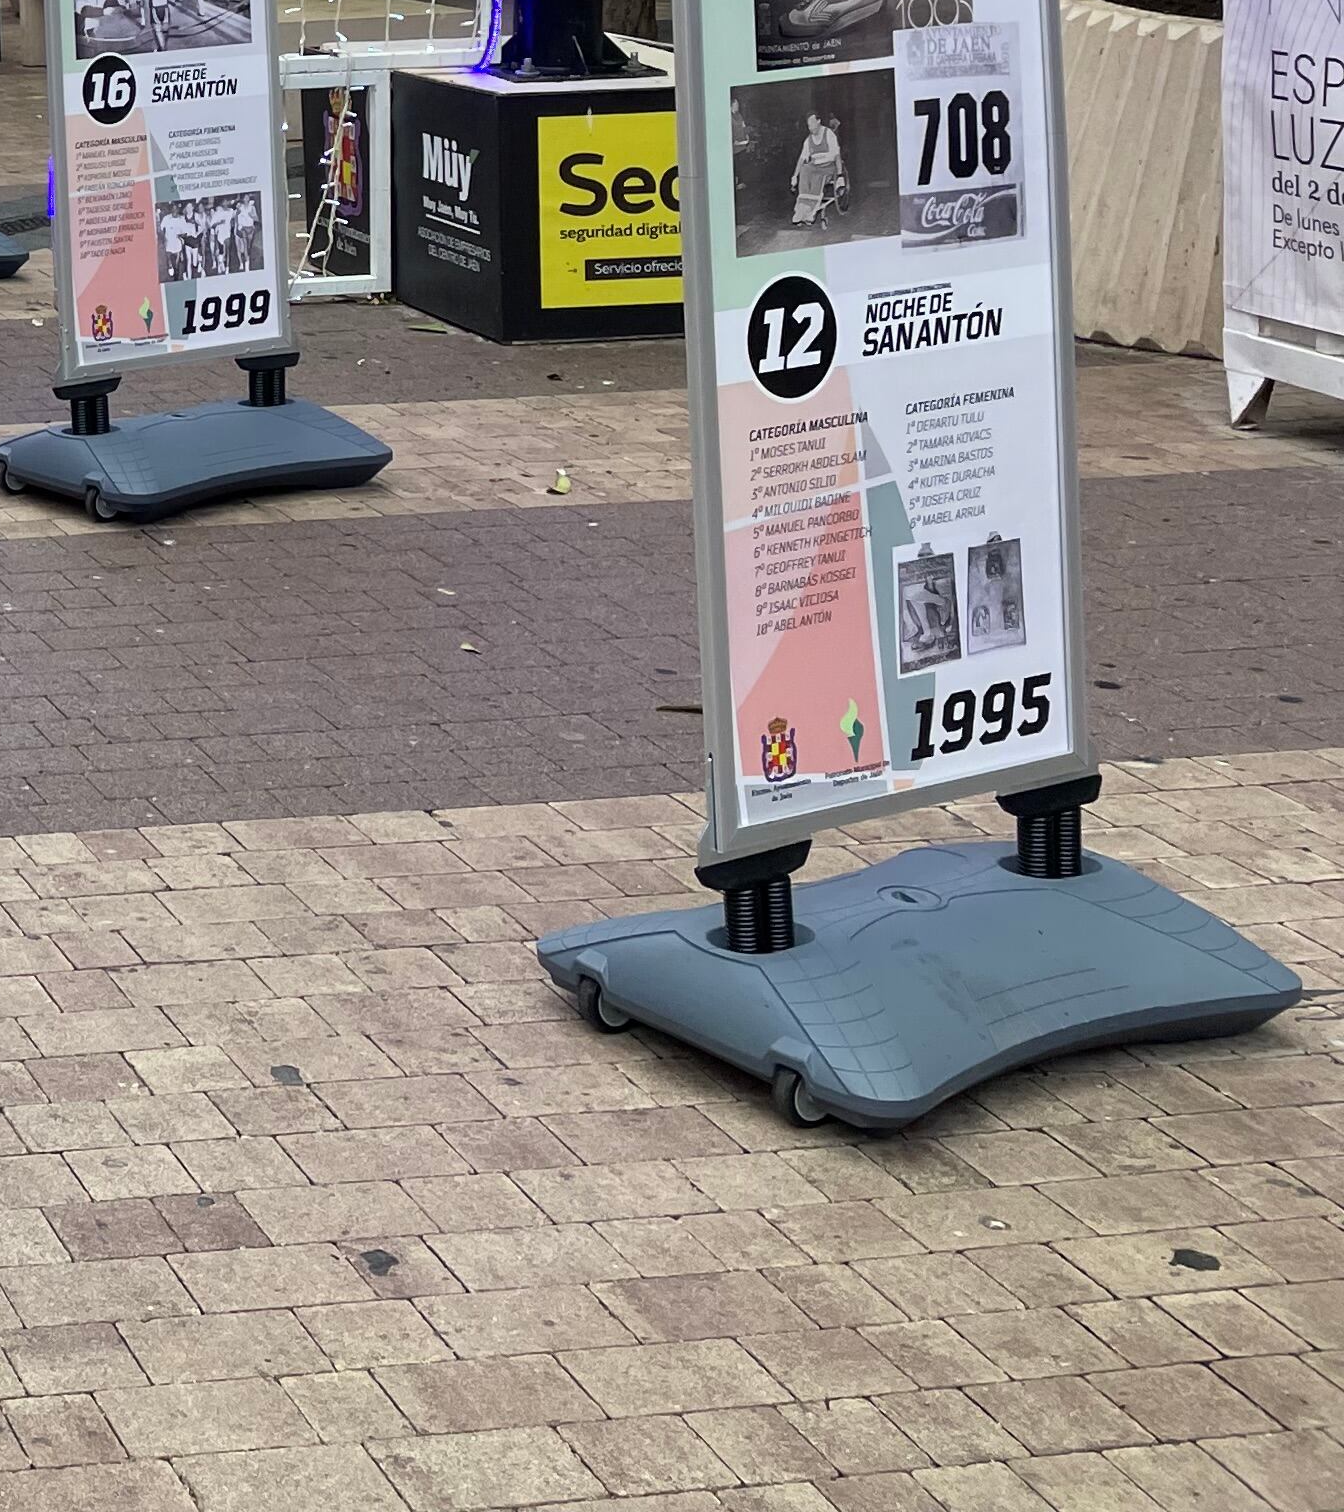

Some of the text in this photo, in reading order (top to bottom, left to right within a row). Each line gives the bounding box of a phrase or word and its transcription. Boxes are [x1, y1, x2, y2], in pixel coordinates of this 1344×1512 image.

[927, 39, 948, 54] DE
[153, 67, 207, 85] NOCHE DE
[88, 71, 131, 110] 16
[152, 74, 237, 103] SAN ANTÓN
[913, 90, 1012, 186] 708
[1271, 110, 1344, 172] LUZ
[1272, 170, 1320, 202] del 2
[560, 222, 682, 242] seguridad digital
[1273, 204, 1340, 236] De lunes
[1273, 229, 1335, 261] Excepto
[594, 262, 641, 275] Servicio
[181, 289, 271, 336] 1999
[865, 291, 954, 323] NOCHE DE
[758, 301, 826, 374] 12
[862, 302, 1004, 357] SAN ANTÓN
[905, 387, 1014, 415] CATEGORÍA FEMENINA
[749, 411, 868, 442] CATEGORÍA MASCULINA
[961, 410, 984, 424] TULU
[761, 437, 826, 460] MOSES TANUI
[919, 428, 992, 451] TAMARA KOVACS
[810, 450, 867, 469] ABDELSLAM
[919, 447, 994, 469] MARINA BASTOS
[763, 480, 807, 498] ANTONIO
[920, 486, 981, 508] JOSEFA CRUZ
[764, 498, 812, 517] MILOUIDI
[922, 510, 952, 526] MABEL
[765, 509, 860, 536] MANUEL PANCORBO
[767, 537, 811, 556] KENNETH
[766, 549, 846, 575] GEOFFREY TANUI
[820, 567, 856, 585] KOSGEI
[768, 590, 839, 614] ISAAC VICIOSA
[774, 617, 798, 632] ABEL
[910, 672, 1052, 762] 1995
